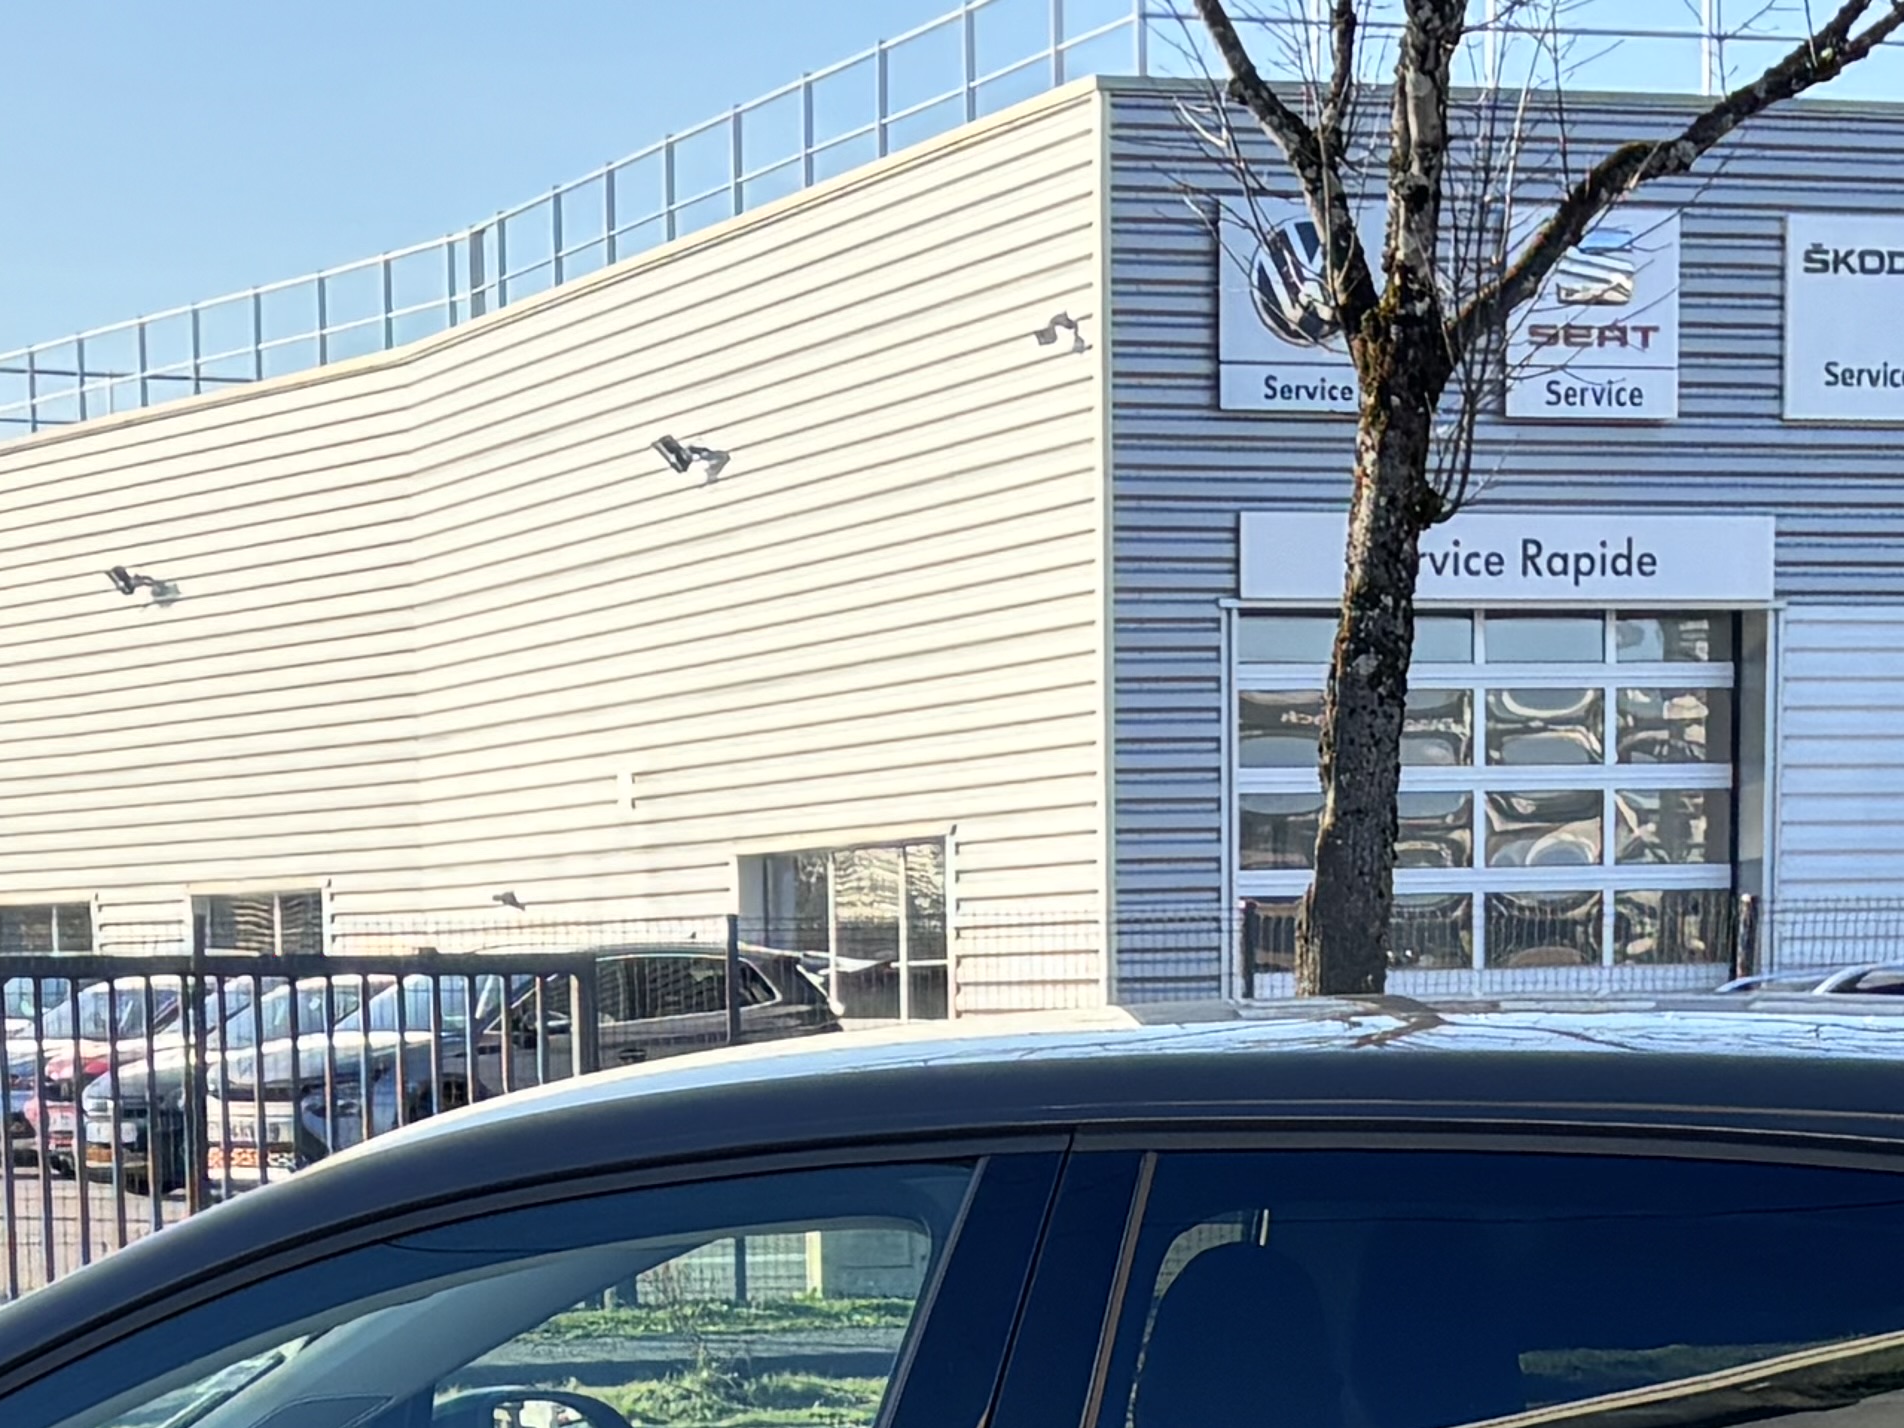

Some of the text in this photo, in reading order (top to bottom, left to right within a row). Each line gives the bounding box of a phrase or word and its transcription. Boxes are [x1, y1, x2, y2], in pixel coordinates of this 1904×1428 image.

[1528, 323, 1660, 349] SEAT
[1263, 374, 1354, 402] Service
[1545, 379, 1644, 407] Service
[1419, 536, 1657, 587] vice Rapide
